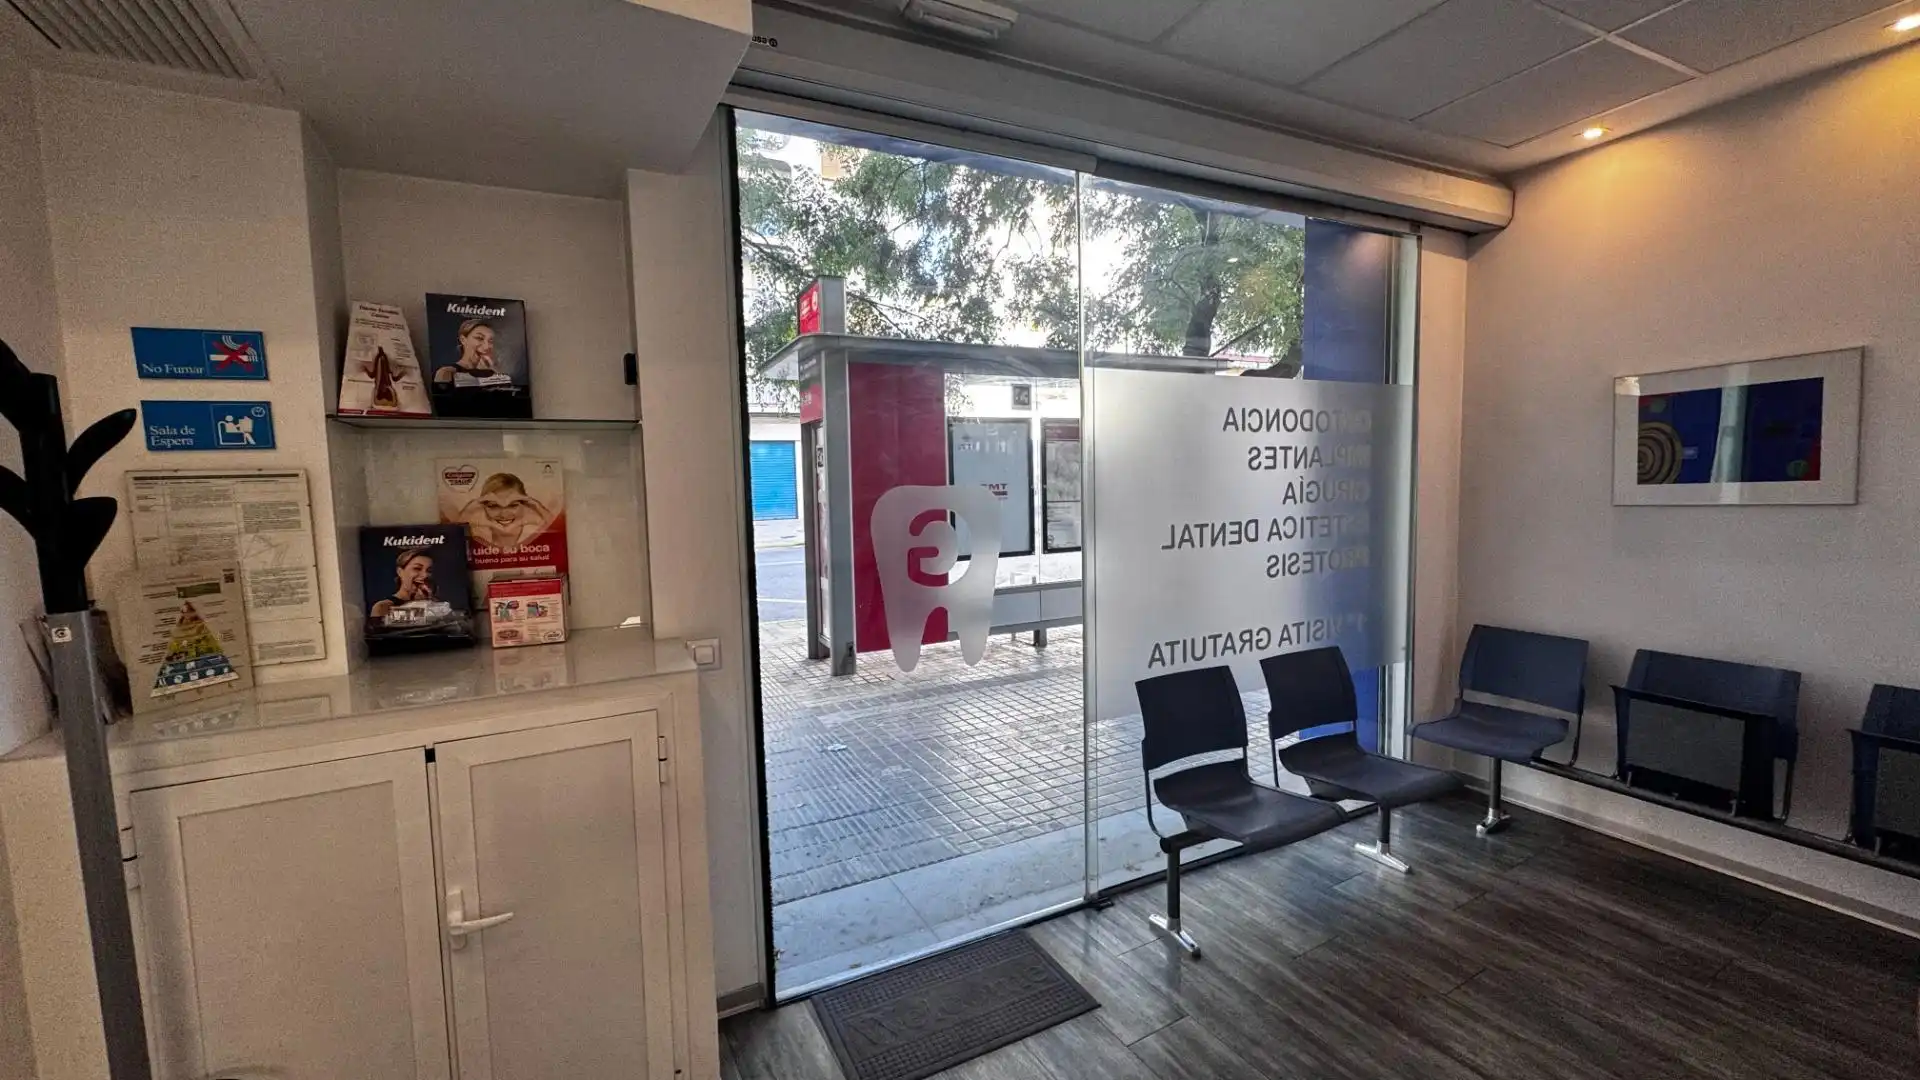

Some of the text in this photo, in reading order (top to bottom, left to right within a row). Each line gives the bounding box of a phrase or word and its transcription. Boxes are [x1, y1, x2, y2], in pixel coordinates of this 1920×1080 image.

[446, 303, 507, 317] Kukident
[141, 363, 204, 375] No Fumar
[149, 424, 196, 436] Sala de
[150, 435, 195, 449] Espera
[383, 534, 446, 547] Kukident
[472, 545, 500, 556] uide
[520, 543, 550, 553] boca
[474, 557, 499, 565] bueno
[500, 556, 518, 564] para
